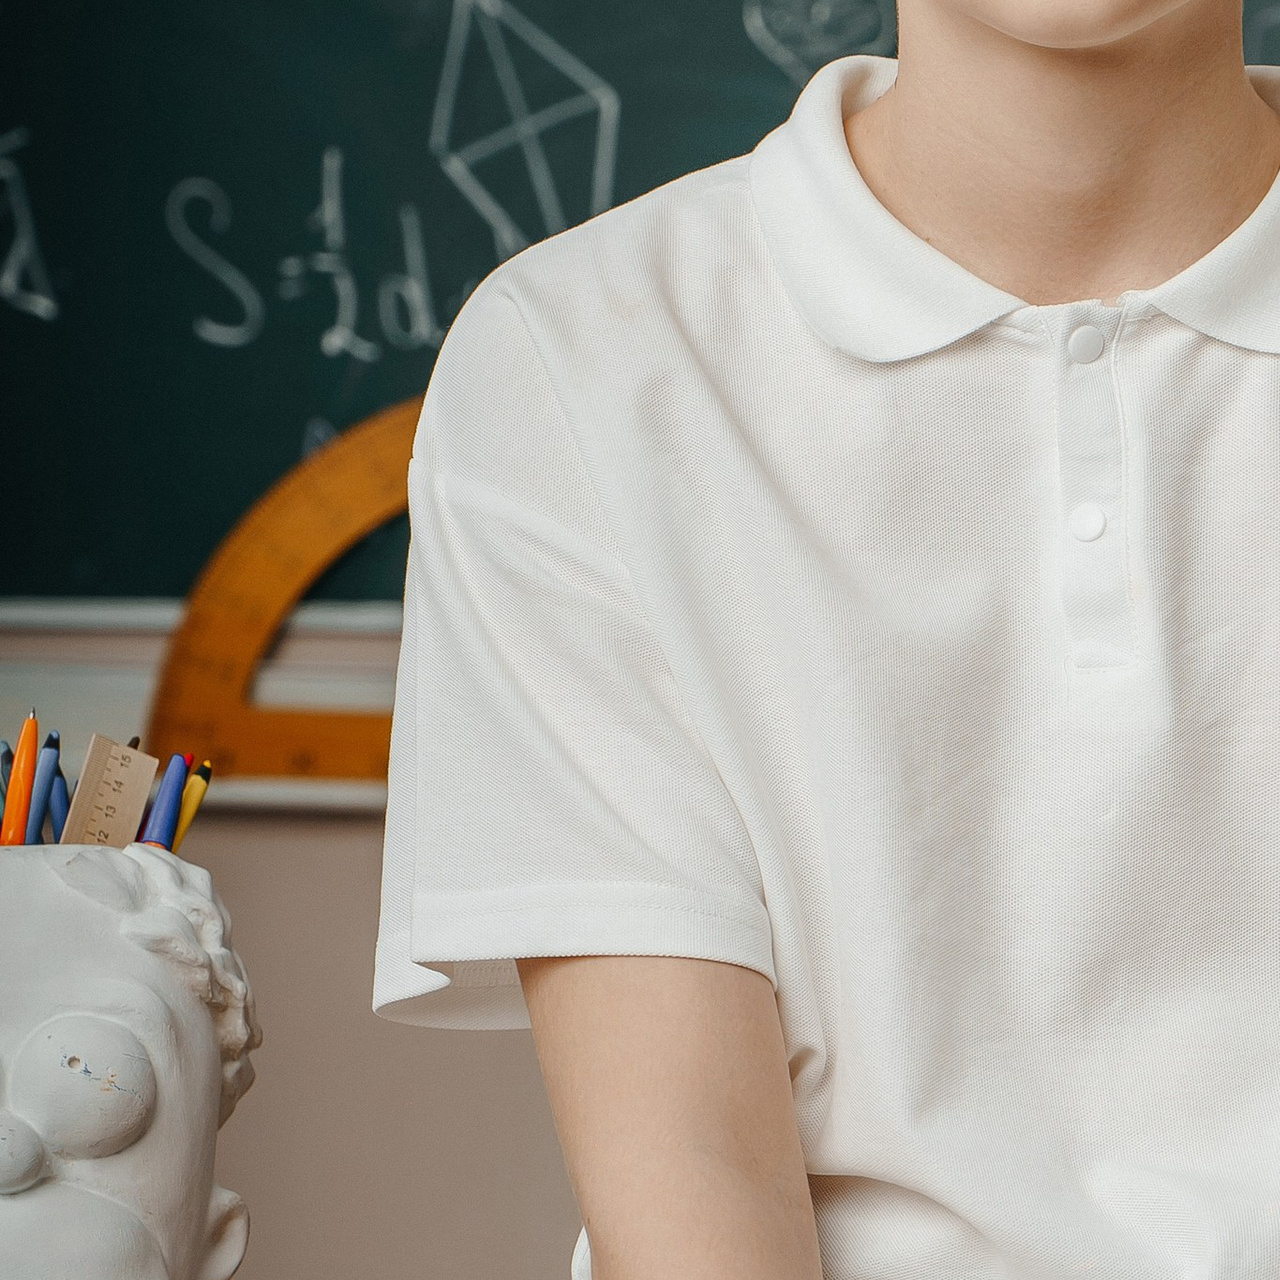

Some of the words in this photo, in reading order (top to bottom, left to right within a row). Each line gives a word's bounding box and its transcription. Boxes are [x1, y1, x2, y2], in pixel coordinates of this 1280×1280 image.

[96, 829, 109, 844] 12
[104, 805, 116, 819] 13
[112, 780, 123, 794] 14
[120, 753, 132, 769] 15
